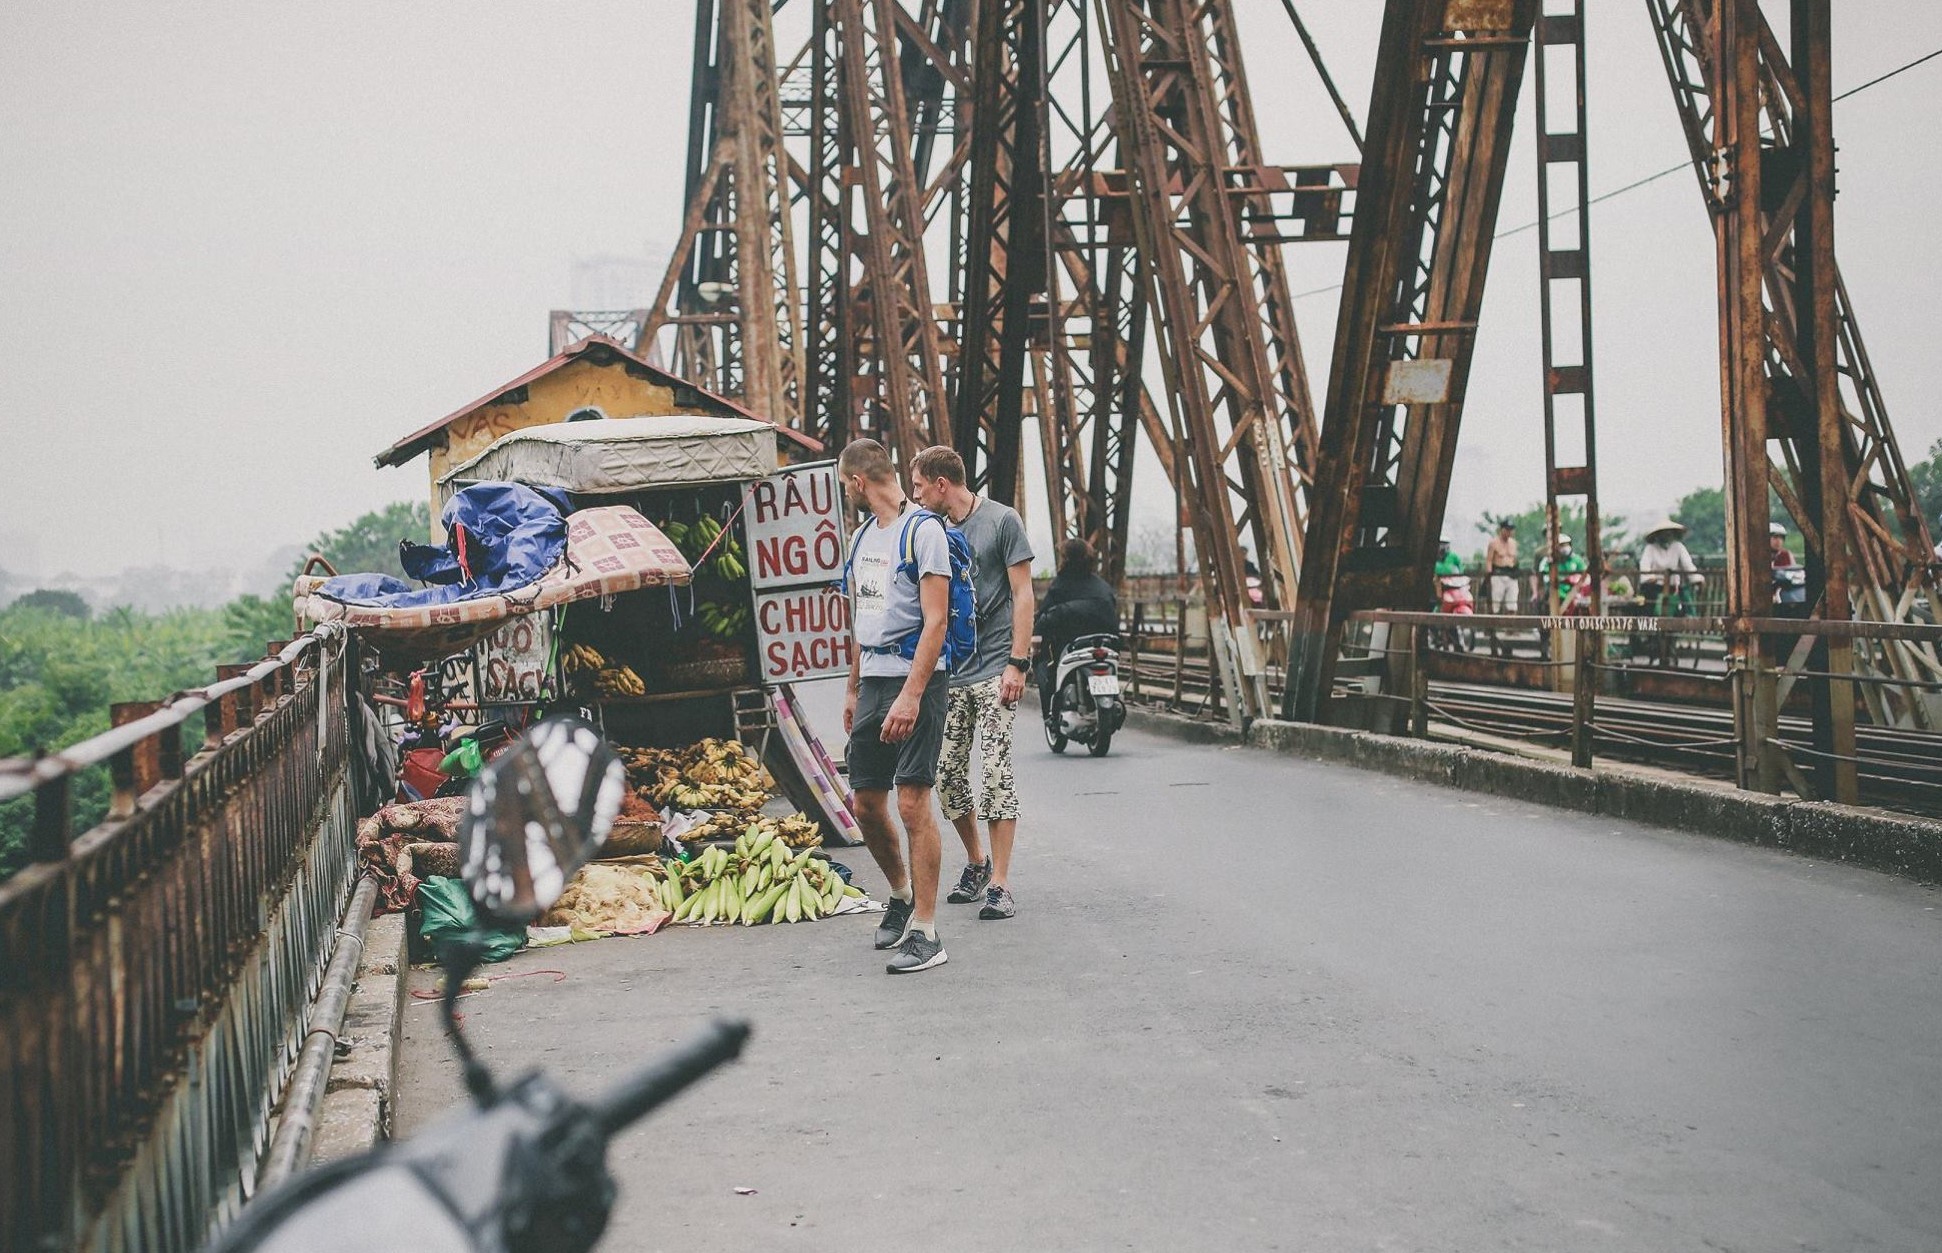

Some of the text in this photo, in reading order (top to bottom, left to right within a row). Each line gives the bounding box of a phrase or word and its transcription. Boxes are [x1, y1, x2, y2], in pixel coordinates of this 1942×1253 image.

[753, 472, 832, 523] RÂU
[756, 519, 840, 578] NGÔ
[768, 635, 853, 677] SẠCH
